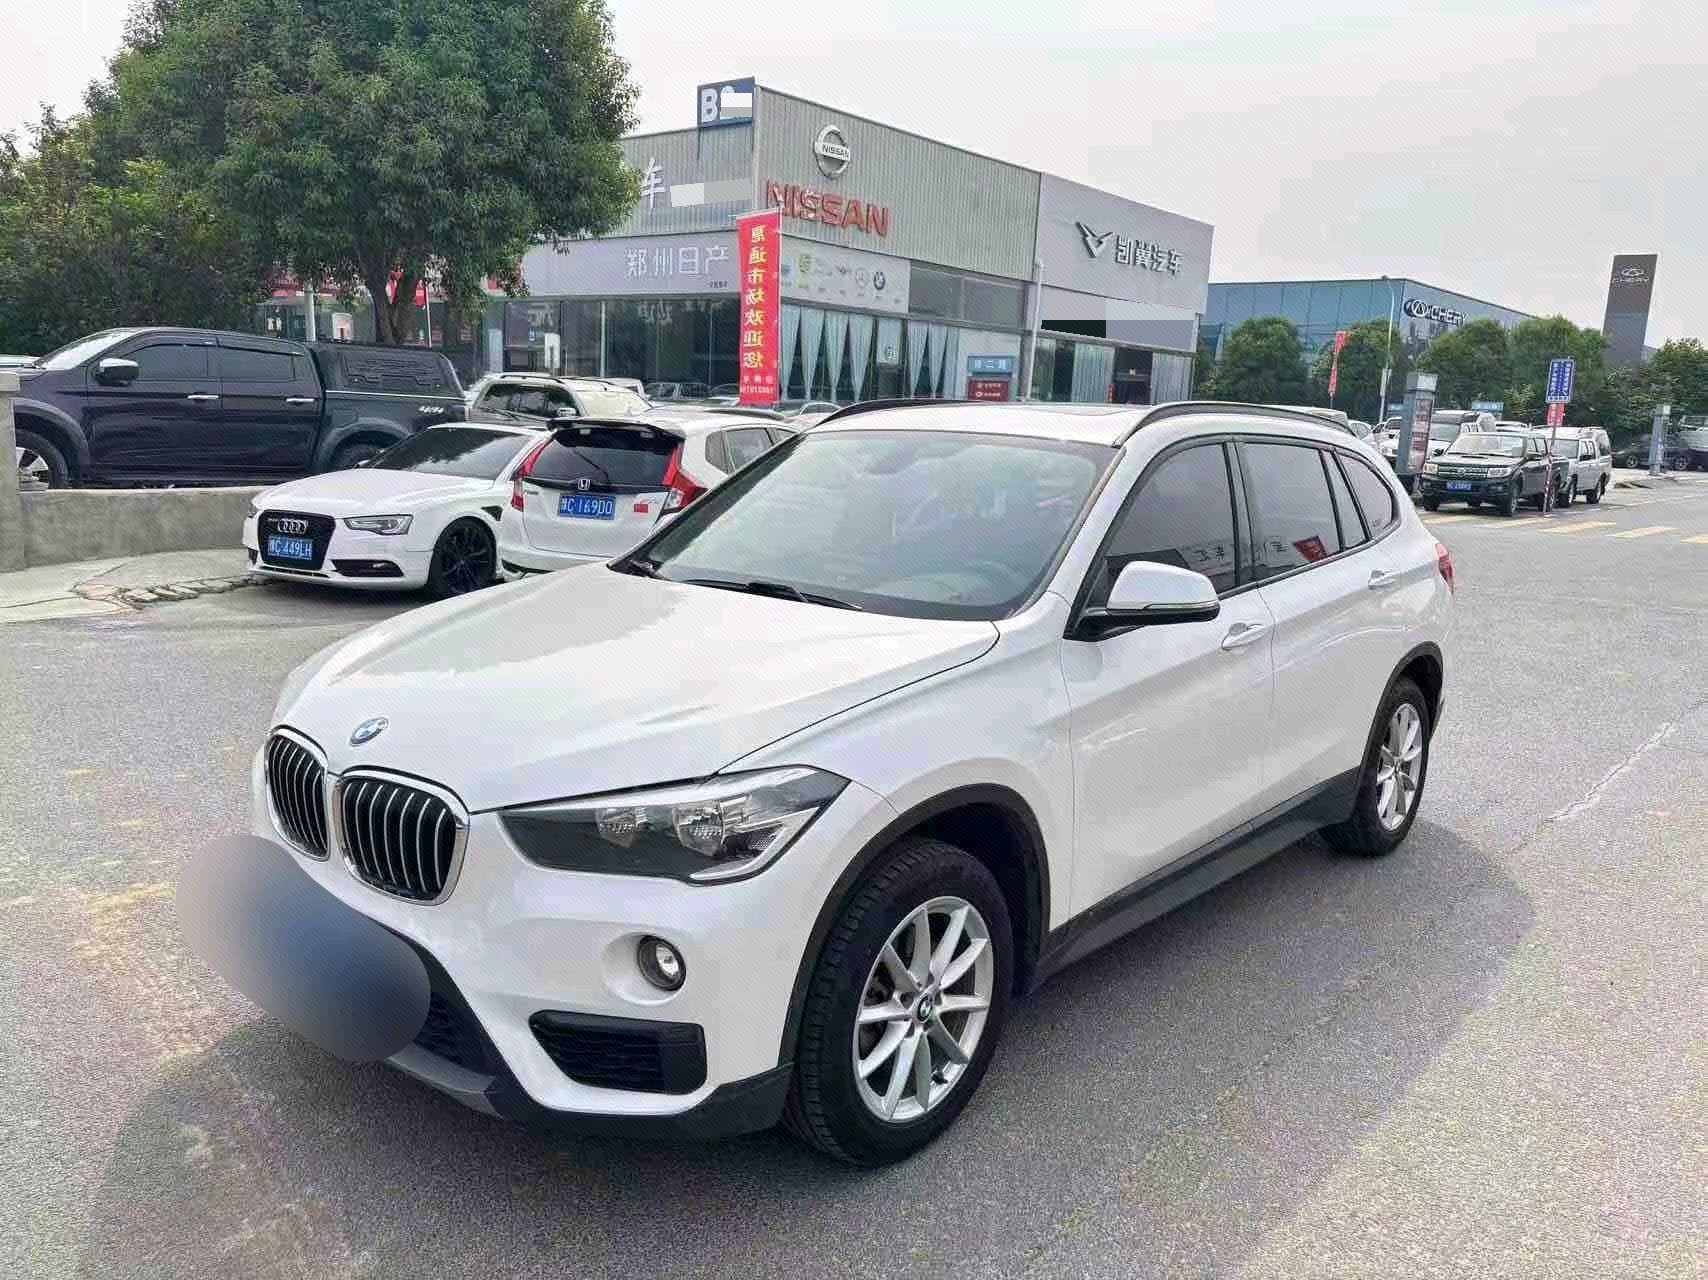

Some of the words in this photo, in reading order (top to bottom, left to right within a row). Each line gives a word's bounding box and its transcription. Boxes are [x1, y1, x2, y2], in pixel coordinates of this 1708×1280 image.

[822, 144, 849, 160] NISSAN
[766, 180, 888, 237] NISSAN
[624, 245, 729, 279] 郑州日产
[1115, 230, 1184, 275] 凯翼汽车
